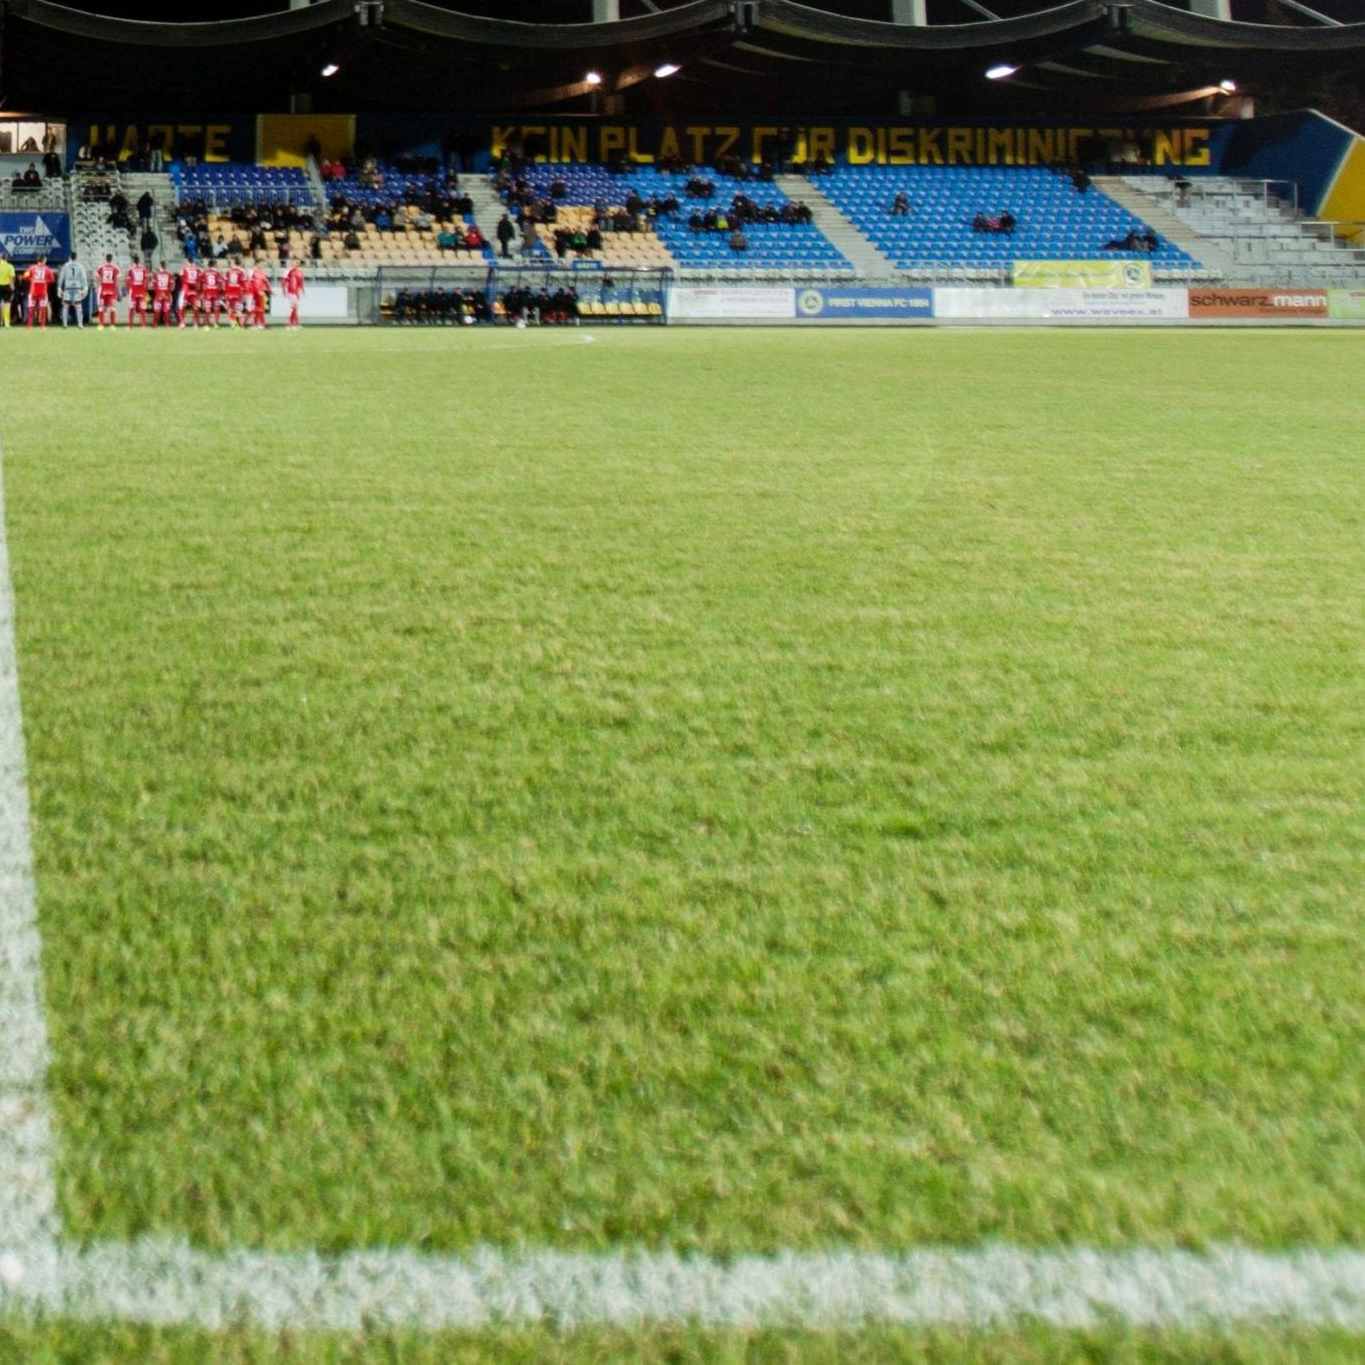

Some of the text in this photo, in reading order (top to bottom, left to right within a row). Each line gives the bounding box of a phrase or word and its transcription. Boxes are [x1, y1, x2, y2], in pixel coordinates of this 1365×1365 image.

[599, 126, 740, 163] PLATZ
[847, 128, 1210, 165] DISKRIMINIENG
[5, 235, 53, 246] POWER
[829, 298, 856, 307] FIRST
[858, 298, 892, 307] VIENNA
